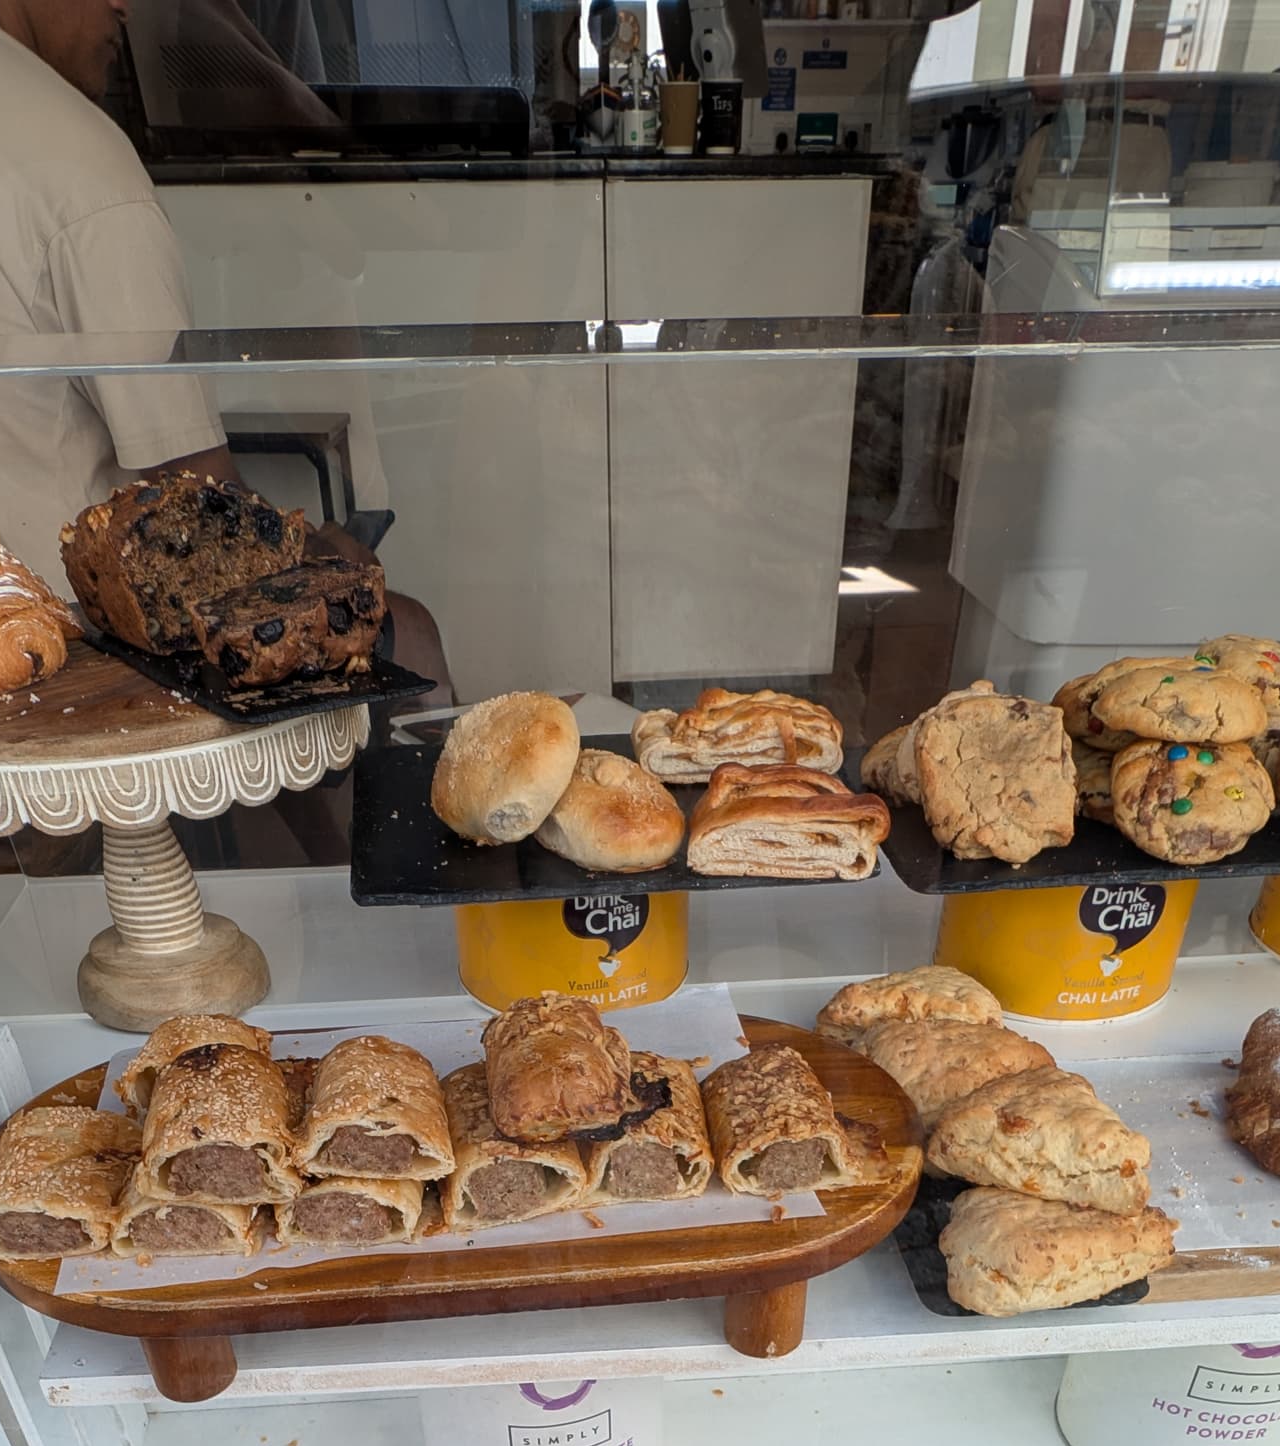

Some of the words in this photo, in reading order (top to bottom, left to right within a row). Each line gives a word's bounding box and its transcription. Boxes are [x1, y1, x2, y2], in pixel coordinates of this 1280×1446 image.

[1091, 887, 1147, 905] Drink
[613, 902, 634, 915] me
[1129, 901, 1150, 913] me
[585, 906, 640, 935] Chai
[1098, 904, 1156, 932] Chai
[608, 982, 648, 1002] LATTE
[1057, 991, 1097, 1005] CHAI
[1100, 985, 1141, 1003] LATTE
[1152, 1397, 1193, 1418] HOT
[523, 1425, 600, 1446] SIMPLY
[1186, 1425, 1267, 1440] POWDER
